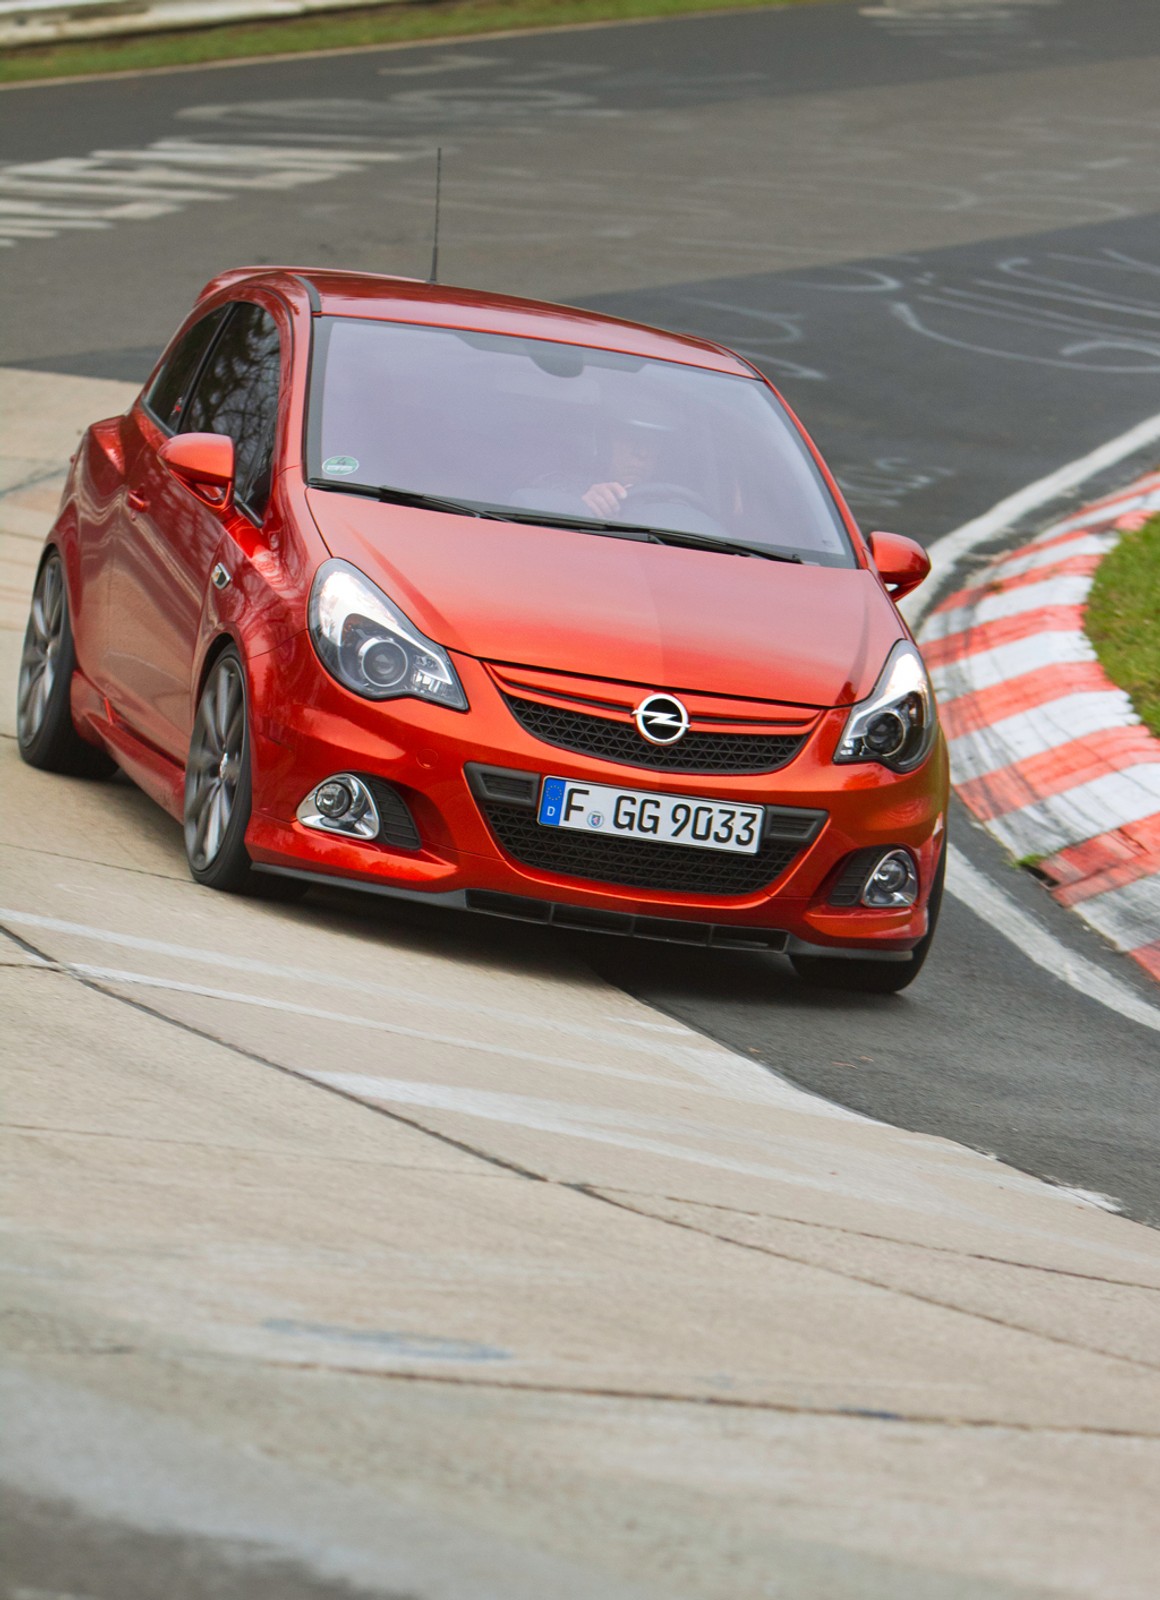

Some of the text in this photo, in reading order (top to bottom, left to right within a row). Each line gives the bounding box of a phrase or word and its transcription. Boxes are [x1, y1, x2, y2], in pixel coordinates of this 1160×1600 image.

[546, 806, 555, 817] D
[563, 788, 758, 847] F GG 9033
